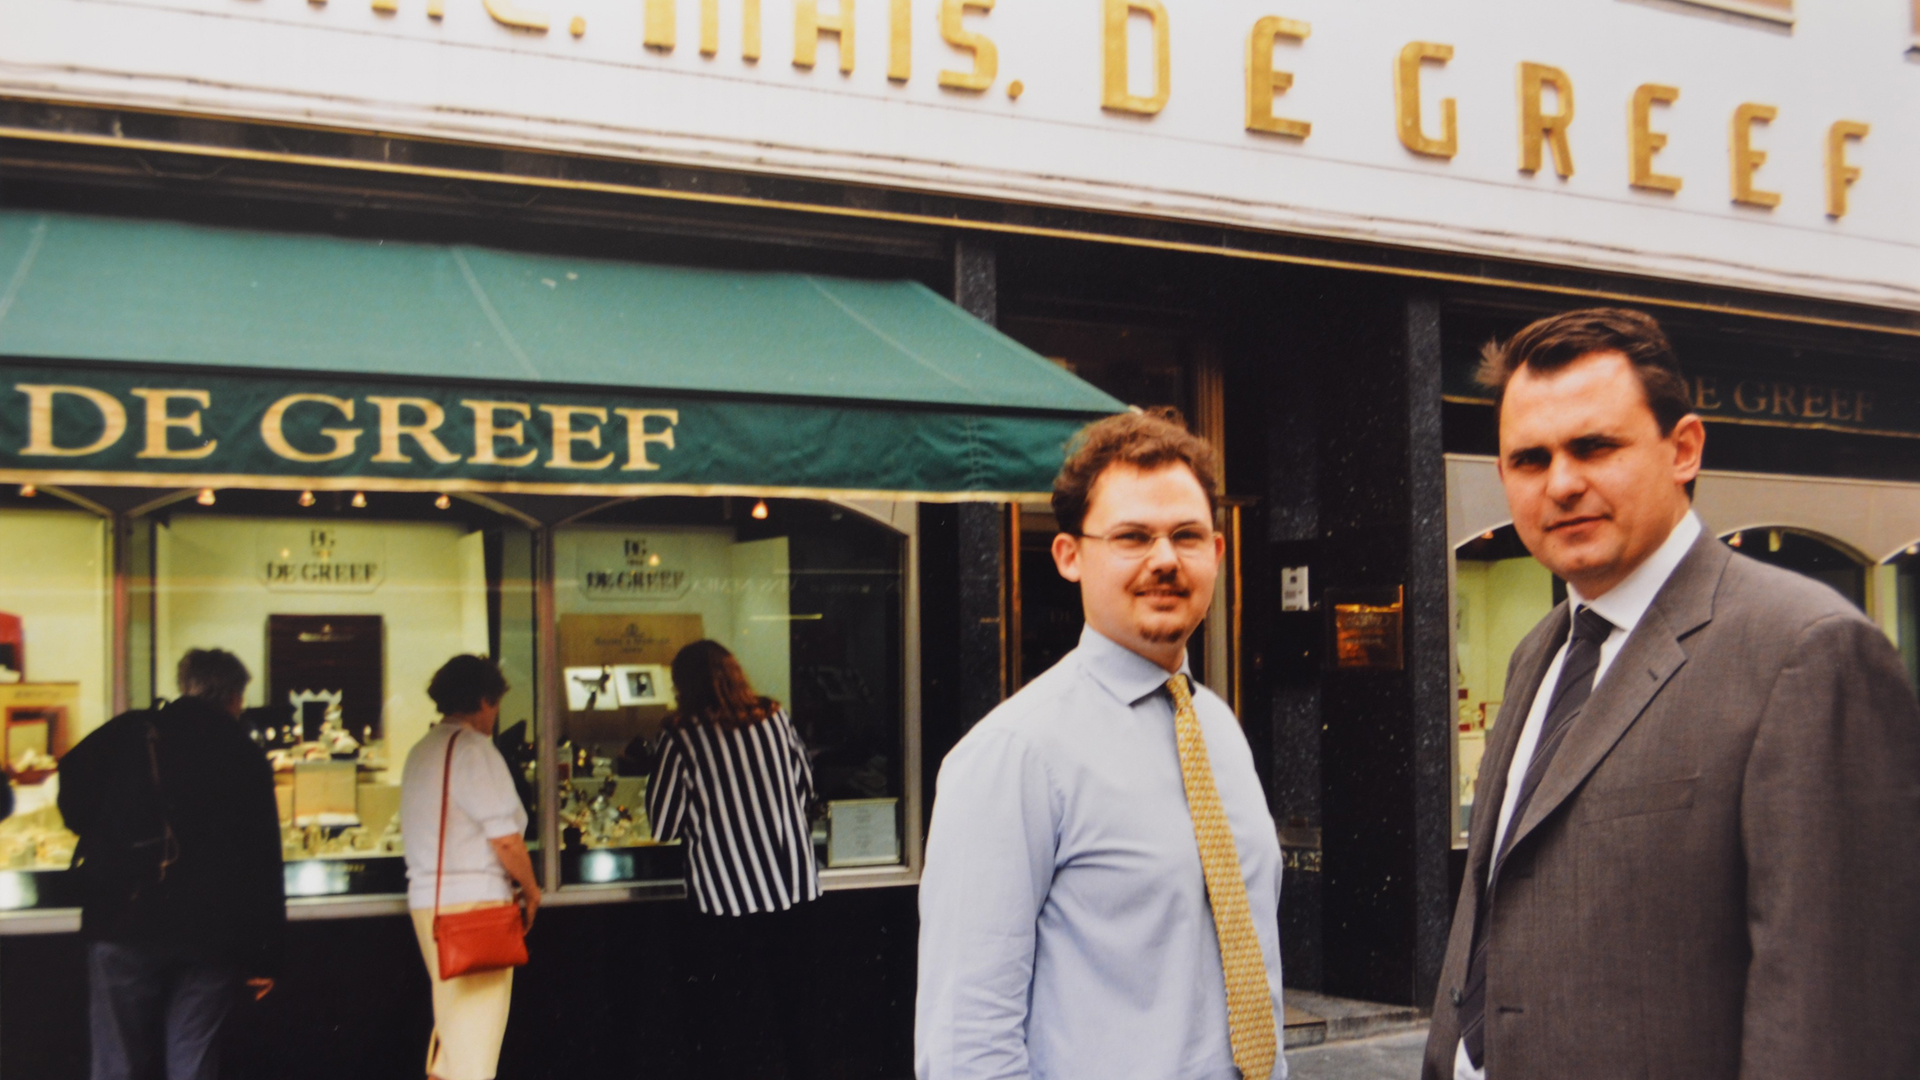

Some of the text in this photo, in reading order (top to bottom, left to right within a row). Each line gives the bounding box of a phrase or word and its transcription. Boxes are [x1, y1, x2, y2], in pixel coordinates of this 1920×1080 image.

[1099, 0, 1312, 141] DE
[1393, 40, 1870, 220] GREEF
[14, 383, 680, 472] DE GREEF
[1733, 381, 1873, 422] GREEF
[266, 562, 378, 583] DE GREEF
